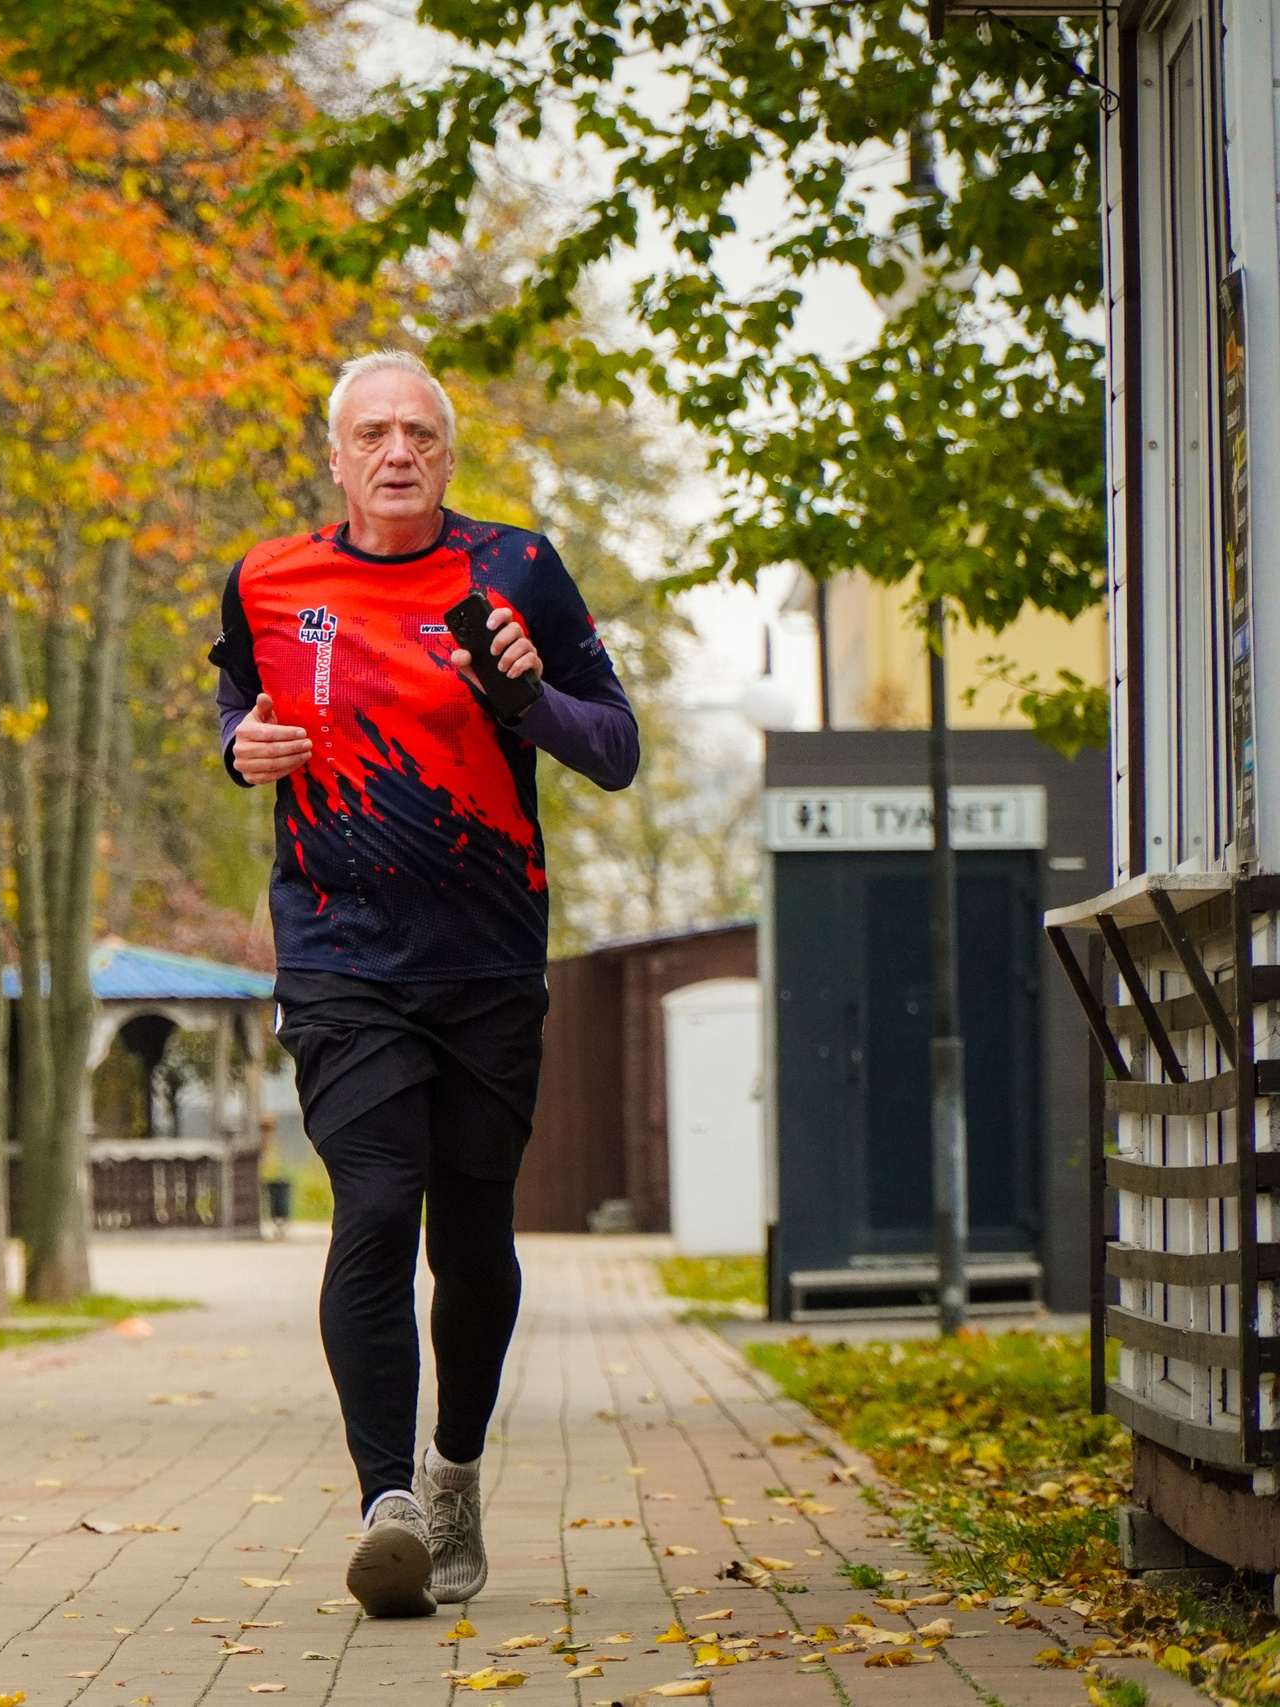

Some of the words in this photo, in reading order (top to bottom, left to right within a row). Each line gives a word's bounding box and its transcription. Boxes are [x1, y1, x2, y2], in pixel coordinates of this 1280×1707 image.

[300, 630, 336, 642] HALF
[421, 625, 450, 633] WORL
[316, 641, 331, 704] MARATHON
[347, 858, 366, 904] TEM
